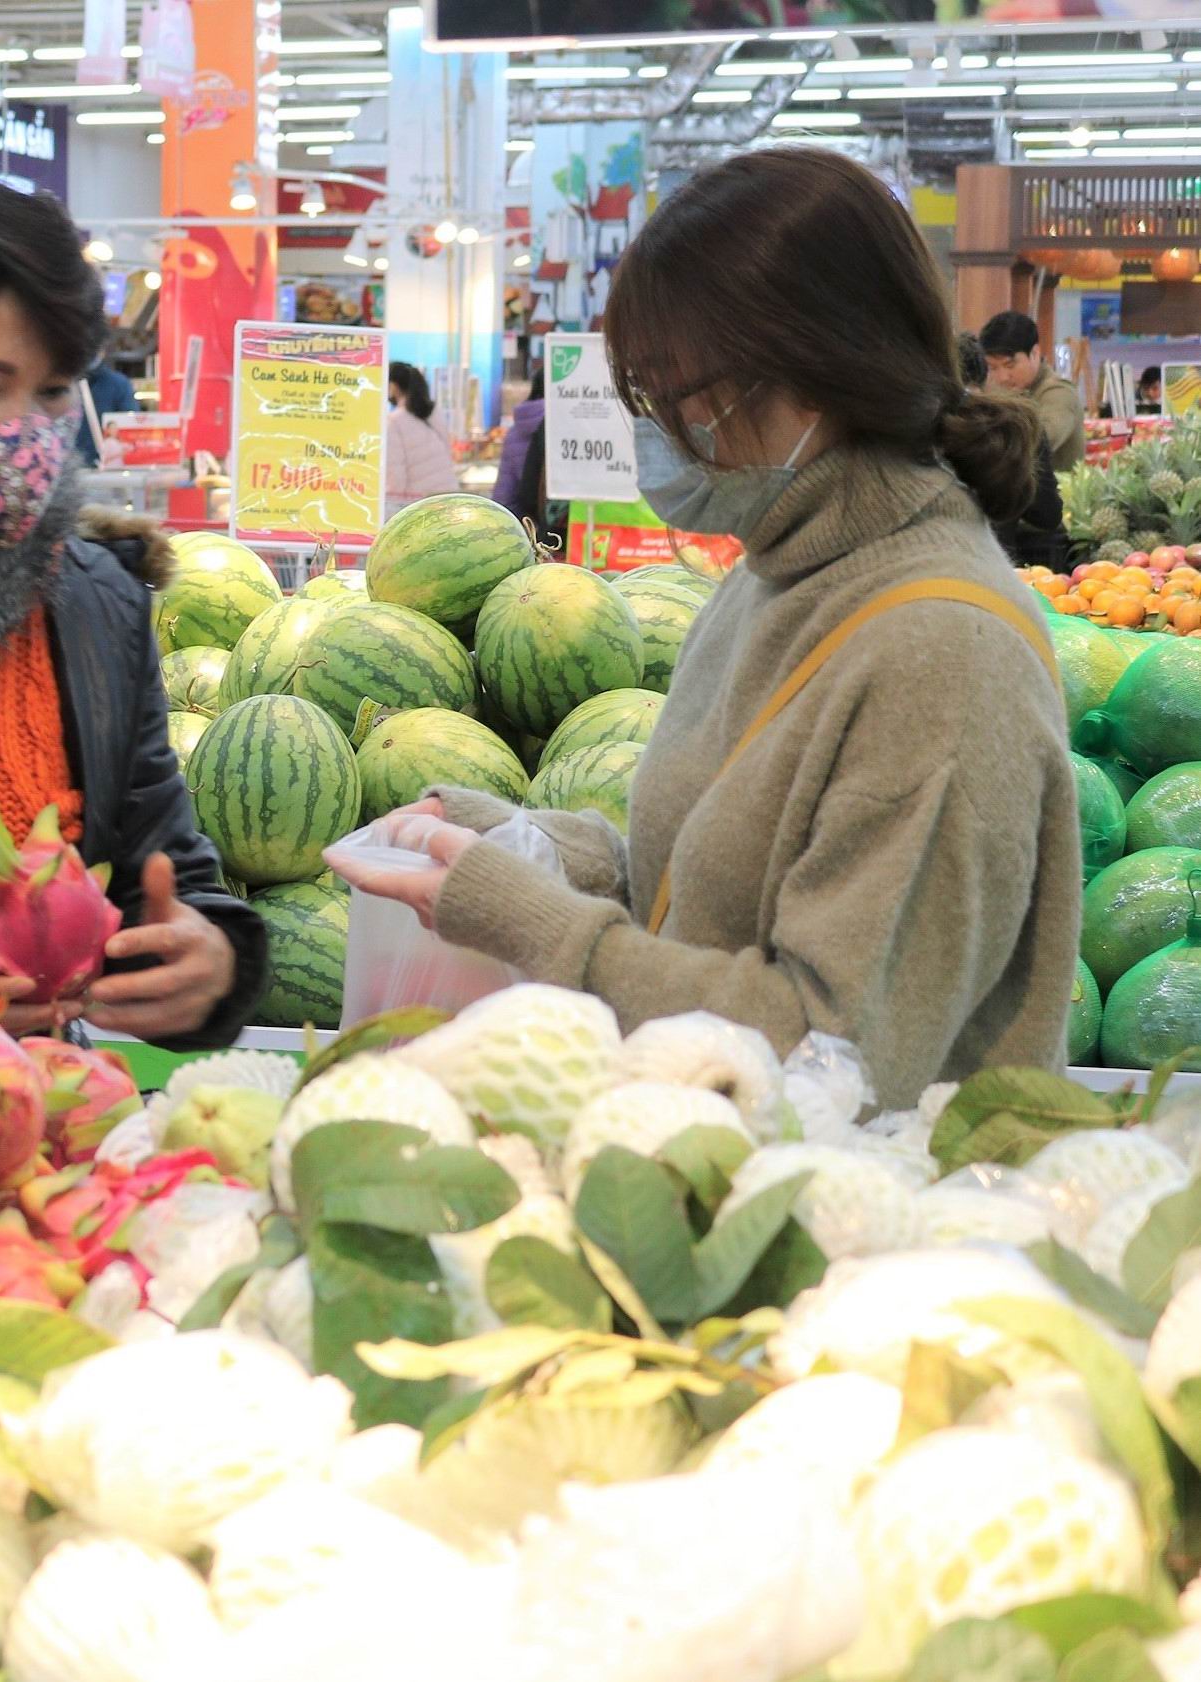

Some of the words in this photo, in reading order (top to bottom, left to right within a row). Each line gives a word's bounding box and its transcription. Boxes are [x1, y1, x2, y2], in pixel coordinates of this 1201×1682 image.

[251, 367, 276, 382] Cam
[334, 371, 364, 390] Gian
[560, 439, 614, 461] 32.900
[251, 463, 323, 491] 17.900
